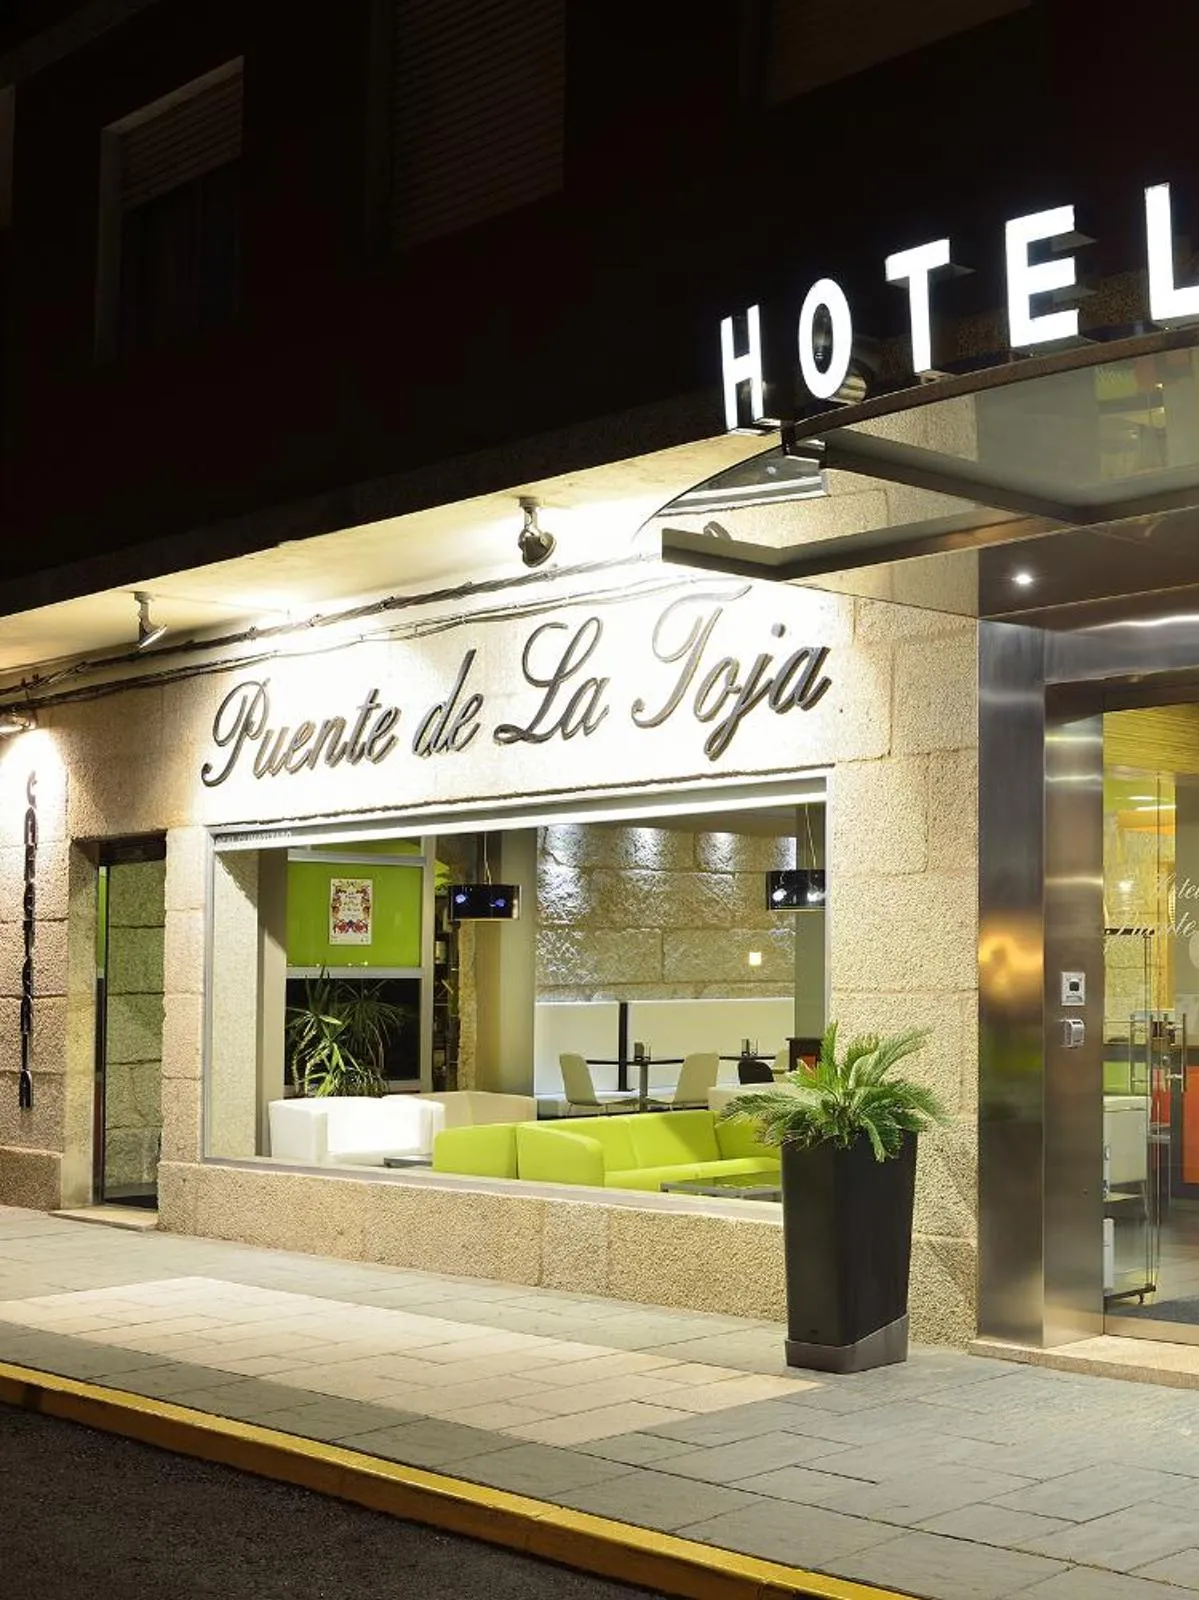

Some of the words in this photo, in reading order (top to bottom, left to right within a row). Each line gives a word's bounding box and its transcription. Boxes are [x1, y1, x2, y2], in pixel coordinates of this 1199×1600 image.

[201, 680, 400, 788] Puente
[411, 648, 484, 759] de
[493, 616, 610, 745] La
[631, 584, 832, 762] Toja
